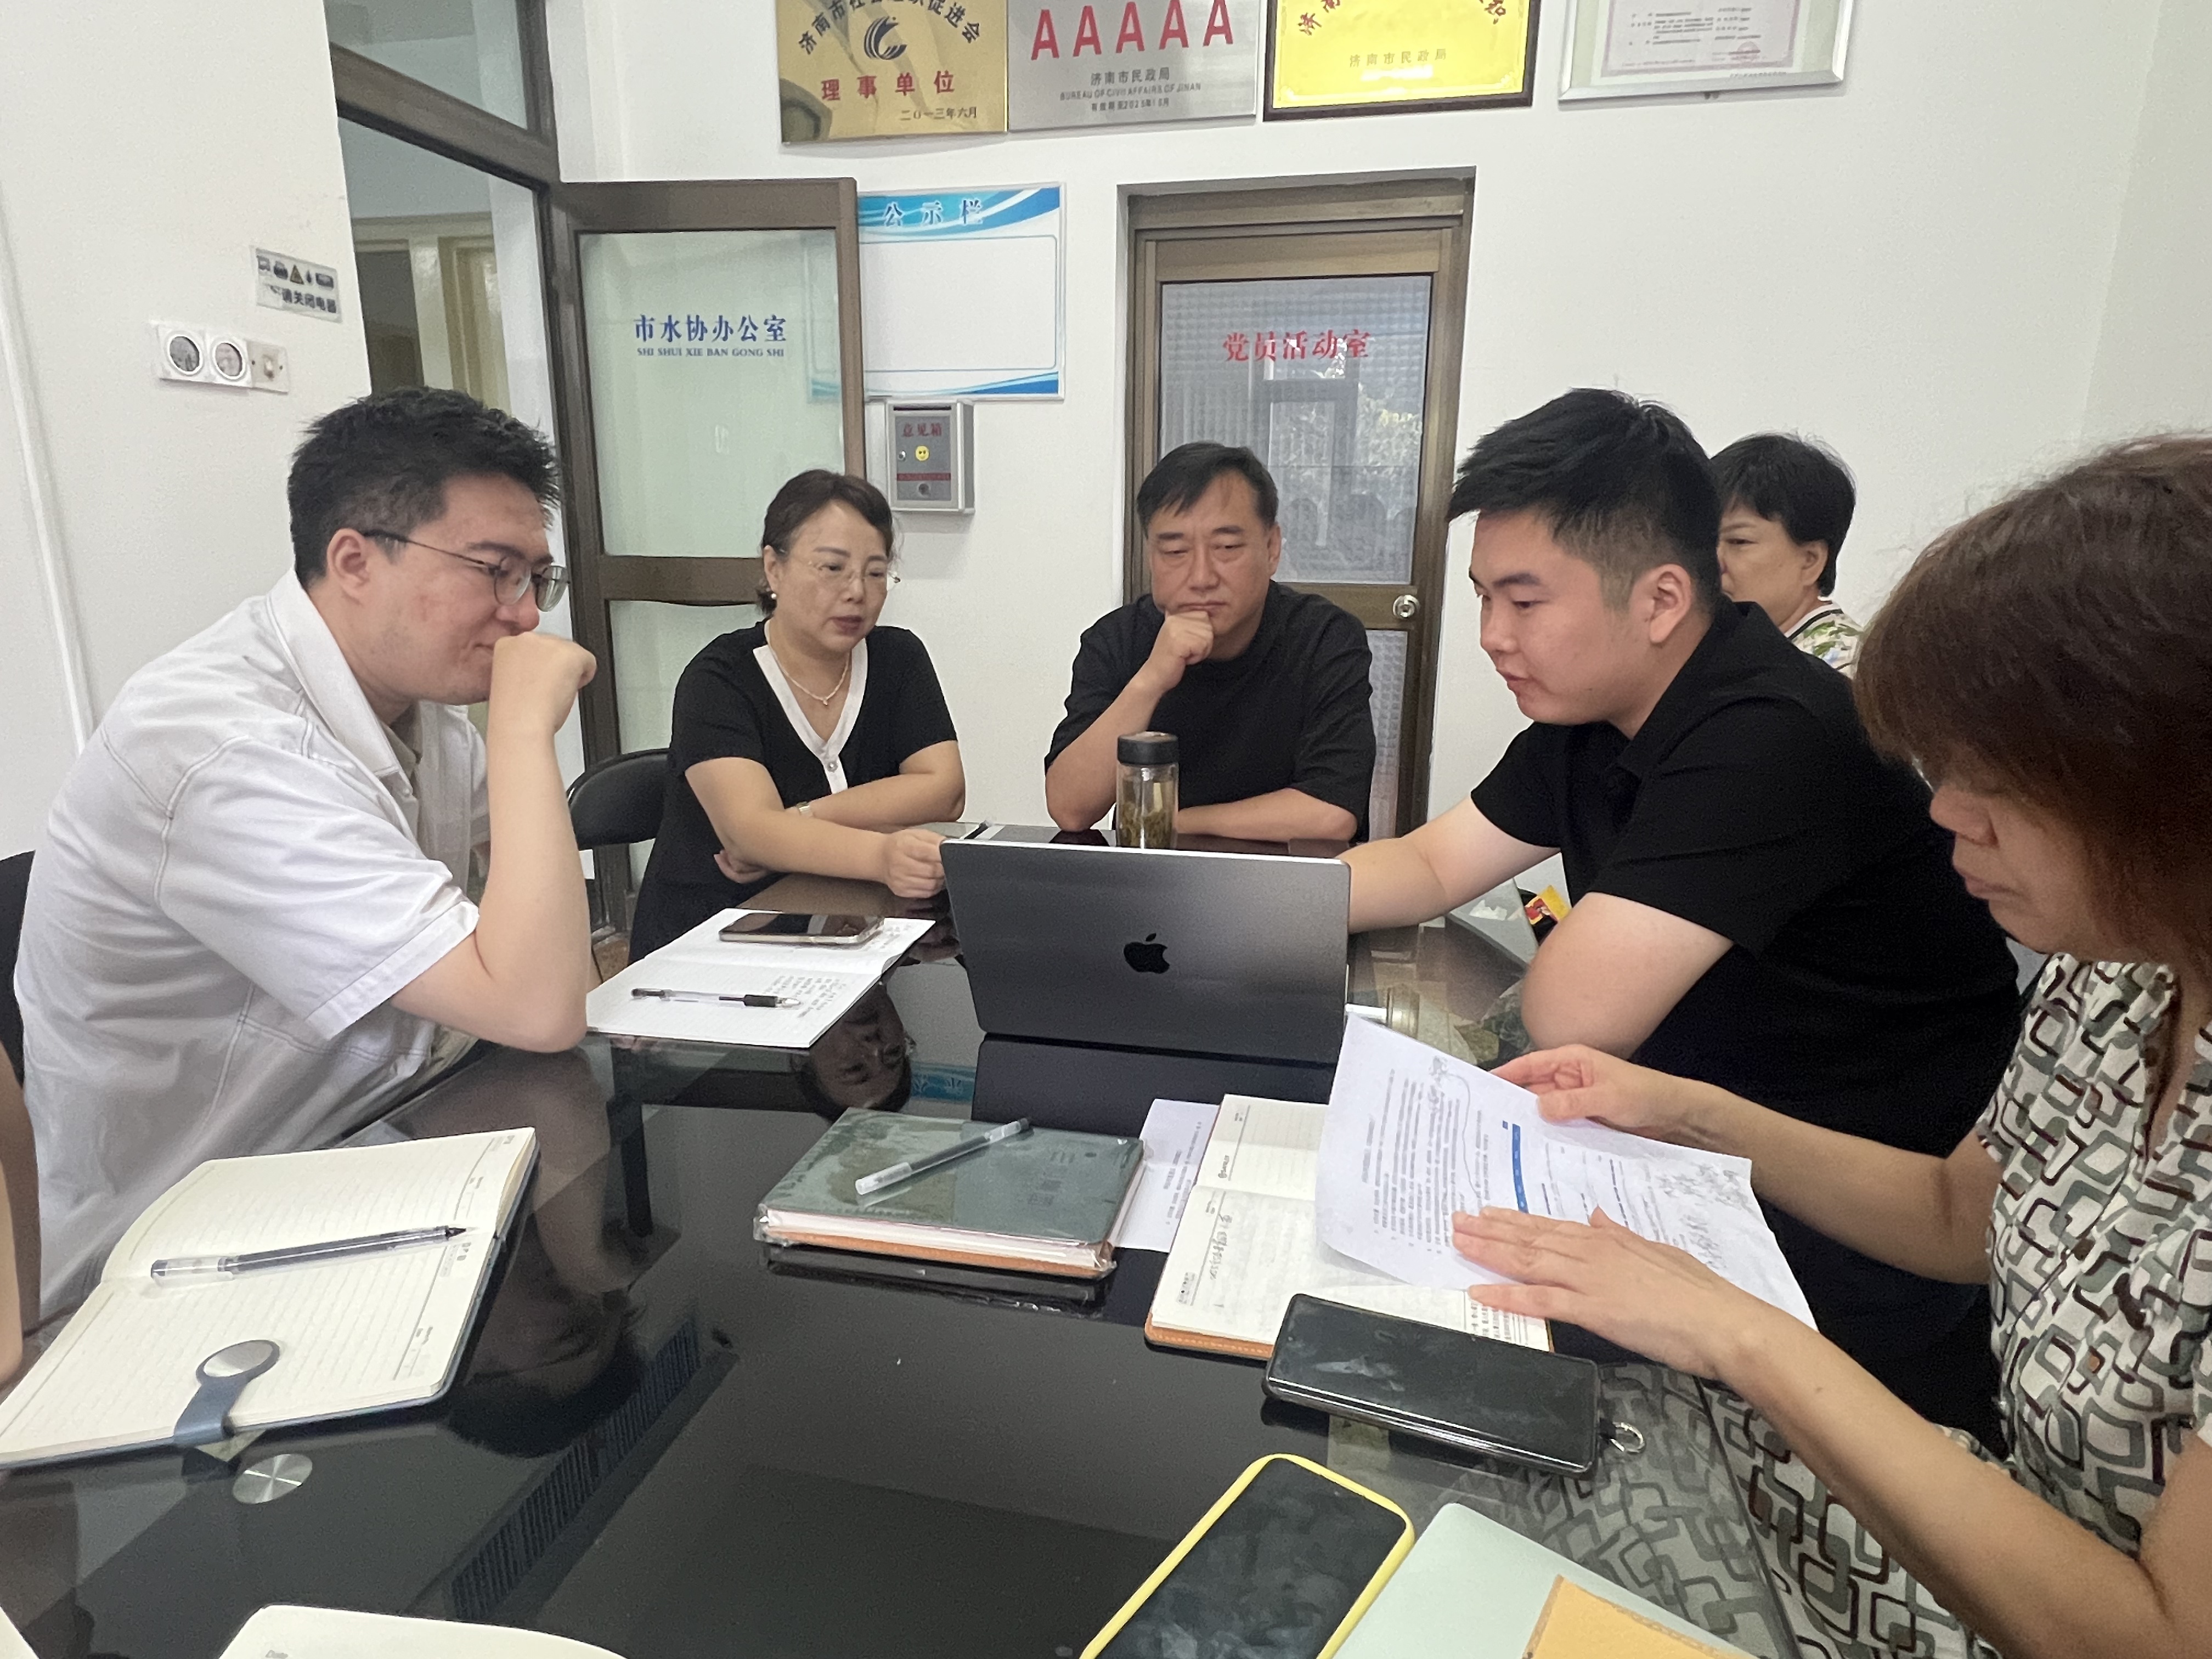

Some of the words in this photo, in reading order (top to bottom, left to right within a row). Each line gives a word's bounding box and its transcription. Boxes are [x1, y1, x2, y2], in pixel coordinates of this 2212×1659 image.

[1031, 0, 1233, 60] AAAAA
[1350, 48, 1447, 67] 济南市民政局
[820, 70, 955, 101] 理事单位
[1091, 67, 1170, 86] 济南市民政局
[1060, 89, 1092, 100] BUREAU
[1094, 88, 1105, 98] OF
[1127, 84, 1163, 96] AFFAIRS
[1164, 83, 1175, 93] OF
[884, 198, 983, 227] 公示栏
[634, 314, 787, 343] 市水协办公室
[637, 348, 654, 357] SHI
[657, 348, 682, 357] SHUI
[686, 348, 703, 357] XIE
[707, 348, 729, 357] BAN
[732, 348, 764, 357] GONG
[766, 348, 785, 357] SHI
[1222, 329, 1372, 362] 党员活动室
